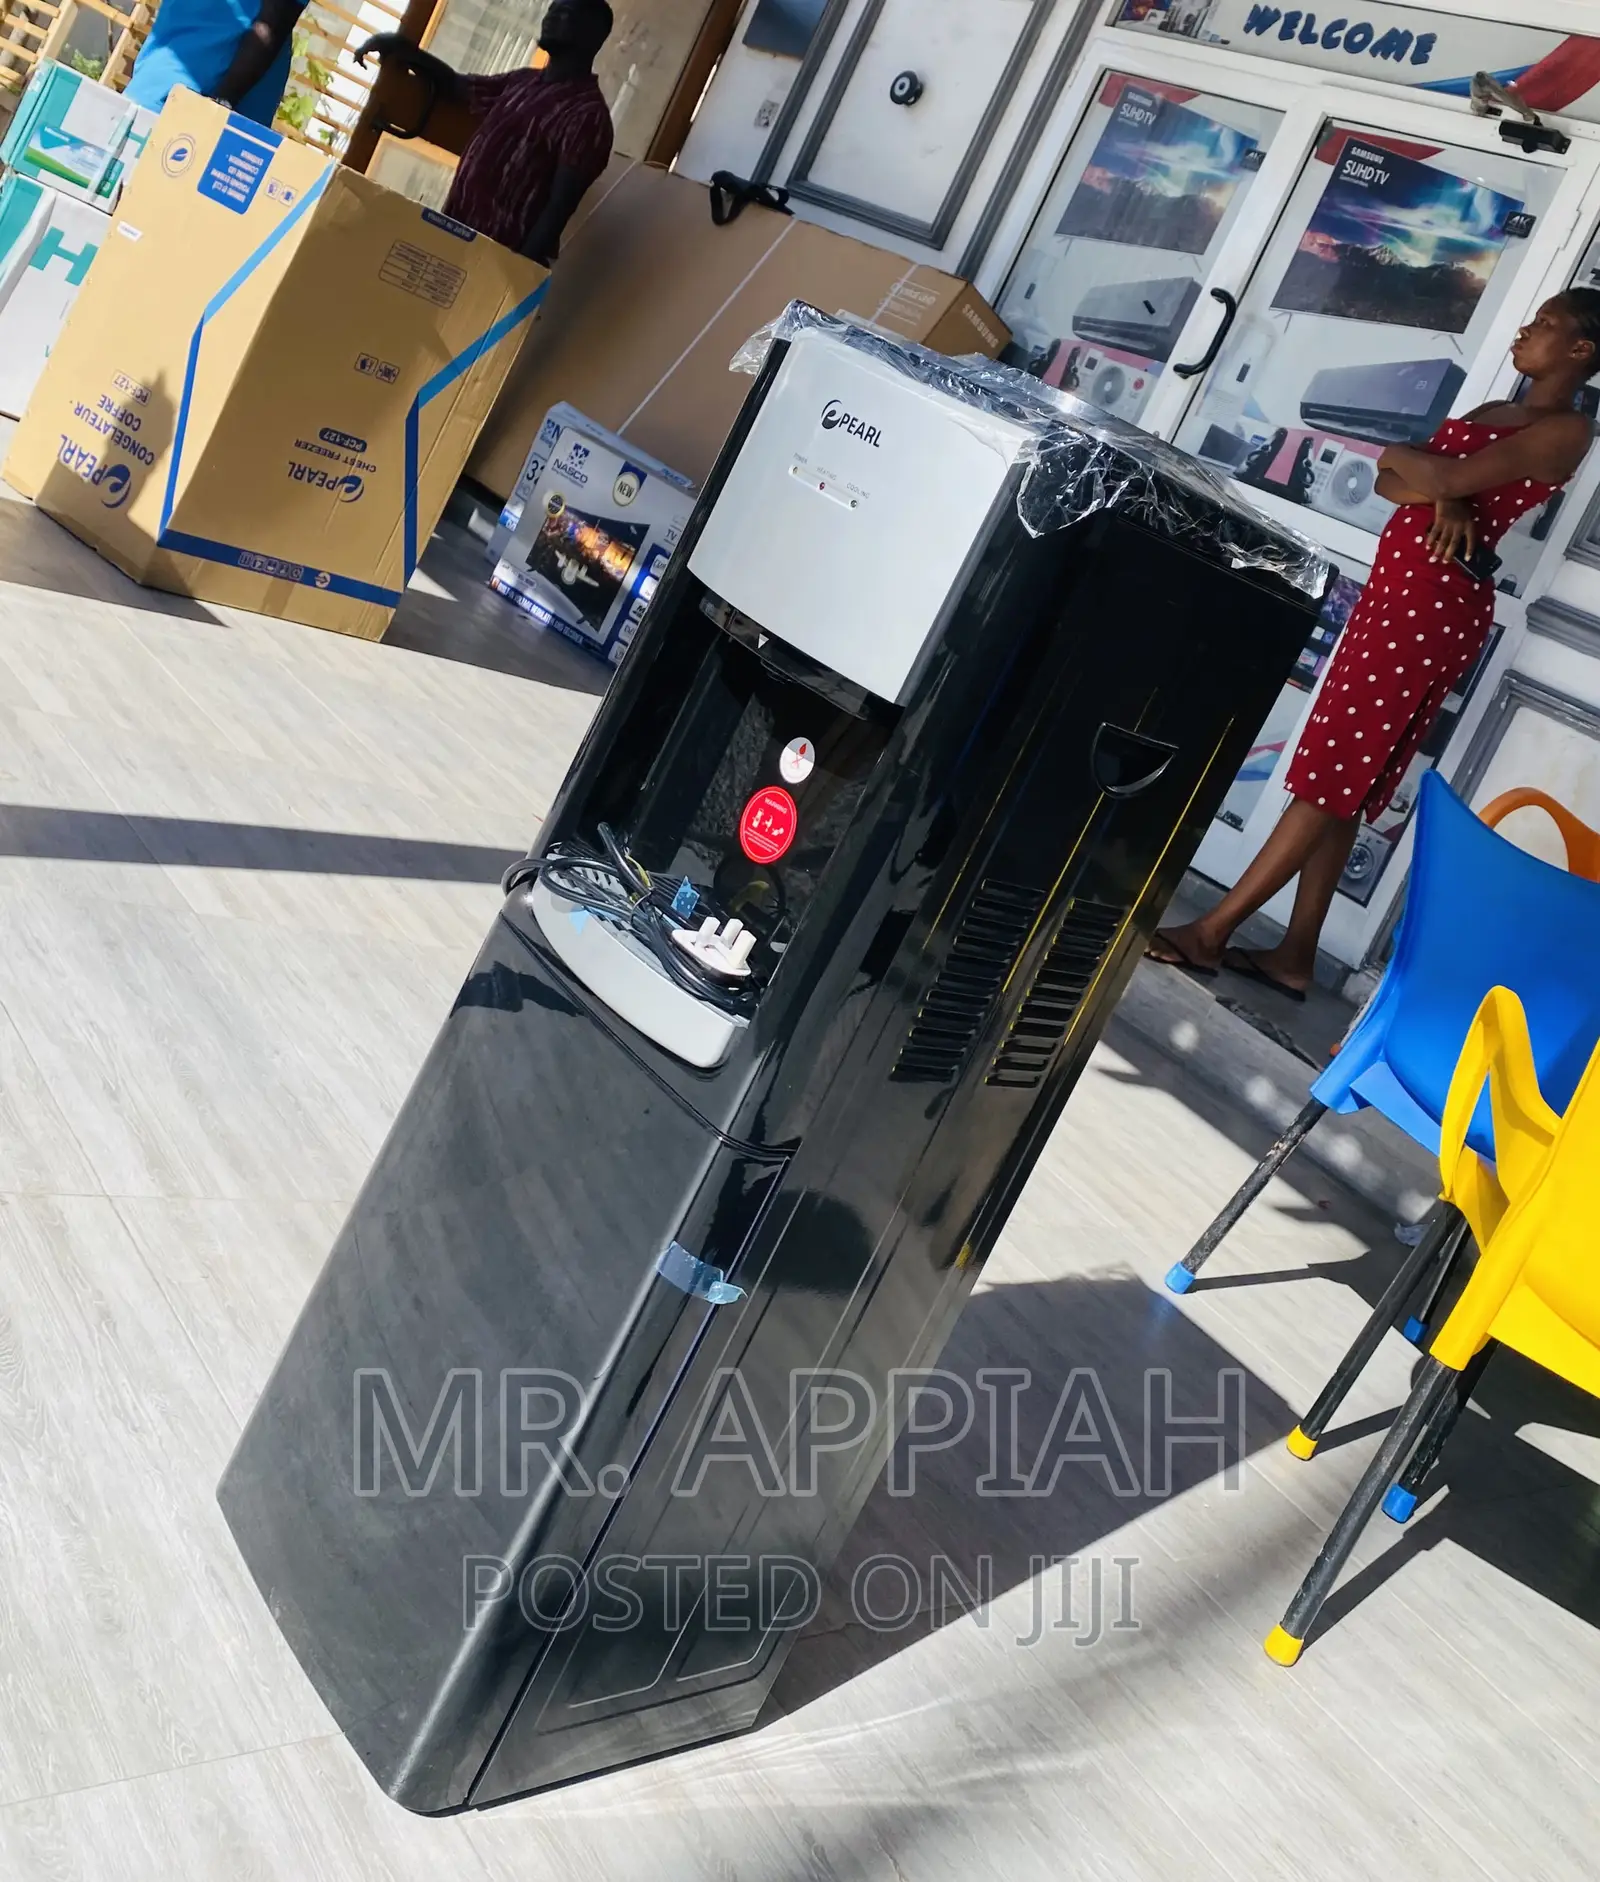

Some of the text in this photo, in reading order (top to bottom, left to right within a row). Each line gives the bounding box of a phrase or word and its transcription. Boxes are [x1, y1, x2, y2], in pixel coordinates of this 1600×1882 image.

[1243, 4, 1437, 65] WELCOME
[1351, 146, 1385, 164] SAMSUNG
[1342, 160, 1375, 179] SUHD
[1374, 170, 1390, 185] TV
[1508, 214, 1530, 228] 4K
[962, 304, 999, 348] SAMSUNG
[114, 374, 150, 403] PCF-127
[97, 394, 141, 432] COFFRE
[73, 402, 155, 466] CONGELATEUR
[323, 430, 364, 450] PCF-127
[839, 412, 882, 448] PEARL
[57, 434, 108, 486] PEARL
[294, 438, 377, 473] CHEST FREEZER
[288, 460, 340, 491] PEARL
[553, 458, 588, 485] NASCO
[817, 467, 837, 481] HEATING
[617, 480, 636, 499] NEW
[846, 482, 871, 499] COOLING
[764, 797, 788, 815] WARNING
